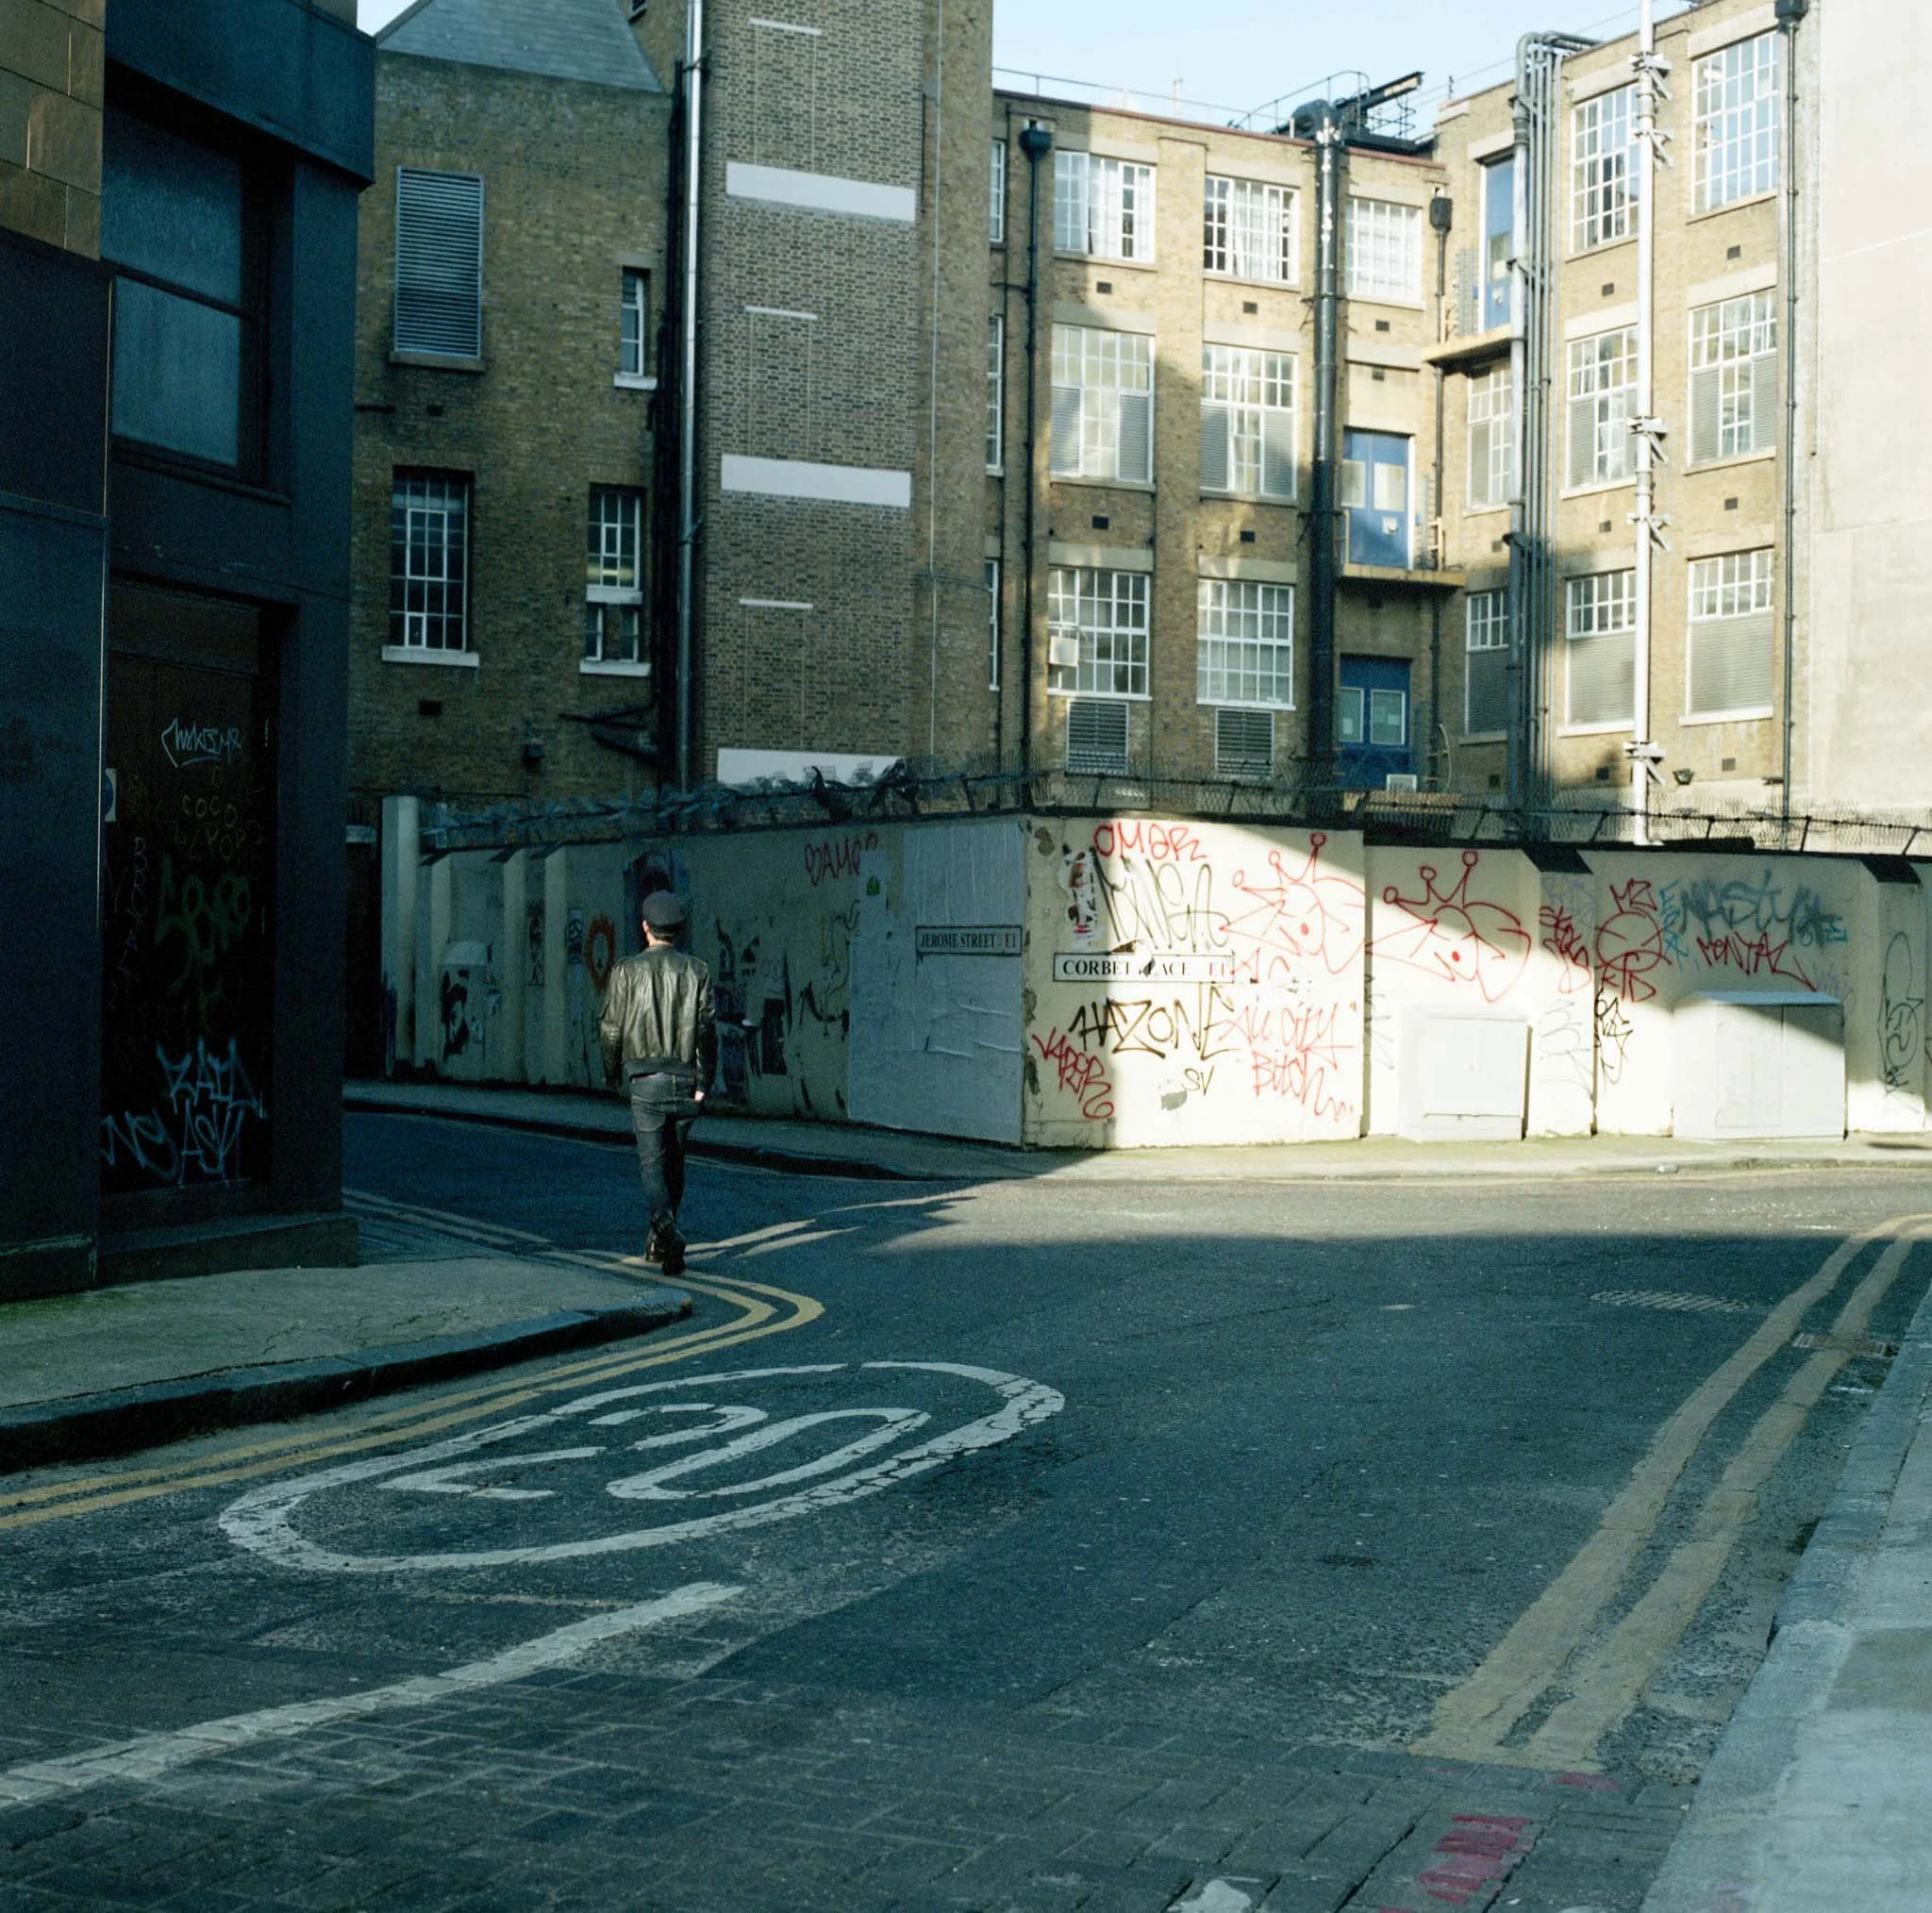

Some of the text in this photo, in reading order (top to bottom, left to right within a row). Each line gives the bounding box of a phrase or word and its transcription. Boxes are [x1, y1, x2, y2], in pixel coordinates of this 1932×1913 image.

[920, 933, 1016, 948] JEROME STREET E1
[1062, 958, 1131, 975] CORBET
[1138, 957, 1189, 976] LACE
[381, 1403, 932, 1500] 20
